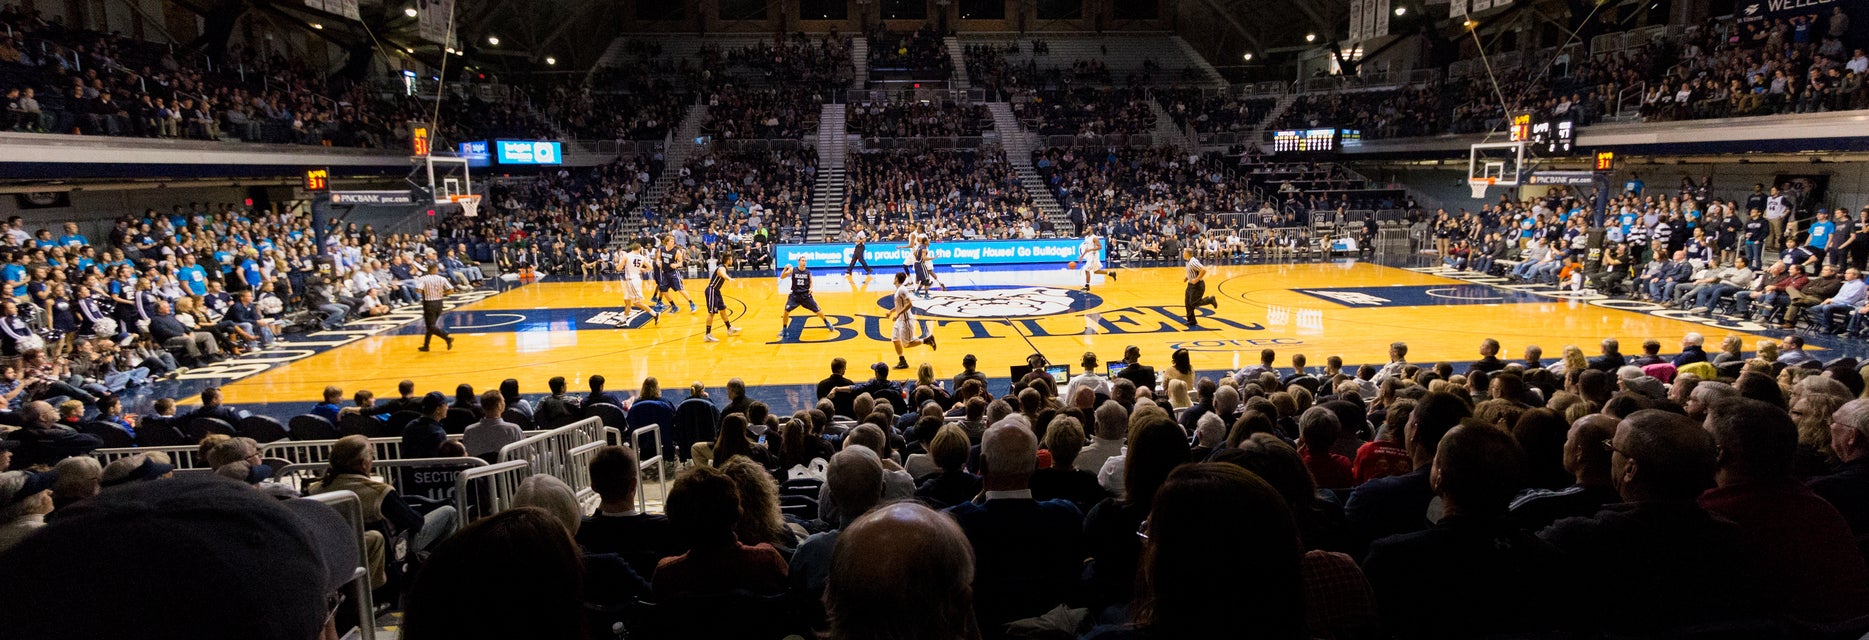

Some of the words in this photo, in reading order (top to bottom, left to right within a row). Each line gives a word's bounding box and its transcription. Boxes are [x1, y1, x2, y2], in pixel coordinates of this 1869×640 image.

[874, 249, 901, 262] proud
[935, 248, 952, 258] the
[953, 247, 981, 260] Dawg
[982, 246, 1015, 258] House!
[1017, 246, 1031, 256] Go
[1033, 245, 1076, 258] Bulldogs!
[632, 258, 641, 268] 45
[765, 305, 1265, 345] BUTLER
[414, 471, 463, 484] SECTIO
